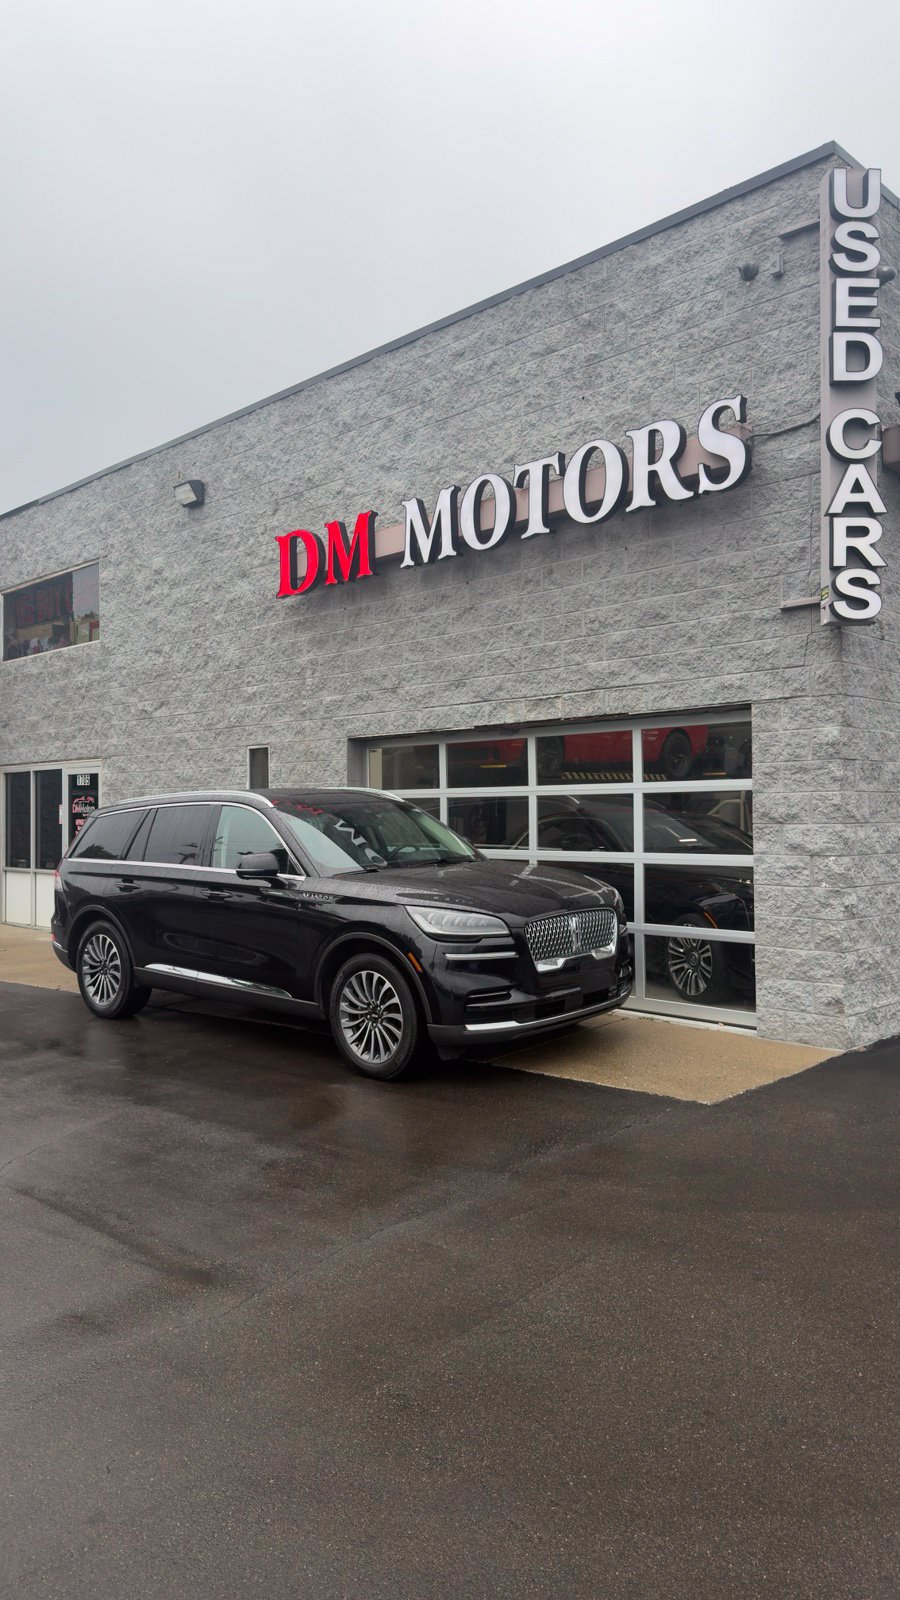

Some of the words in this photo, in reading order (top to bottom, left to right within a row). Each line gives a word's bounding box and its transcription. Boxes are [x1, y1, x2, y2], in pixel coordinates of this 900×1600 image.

[830, 167, 883, 384] USED
[275, 510, 377, 598] DM
[400, 394, 747, 569] MOTORS
[827, 408, 887, 620] CARS
